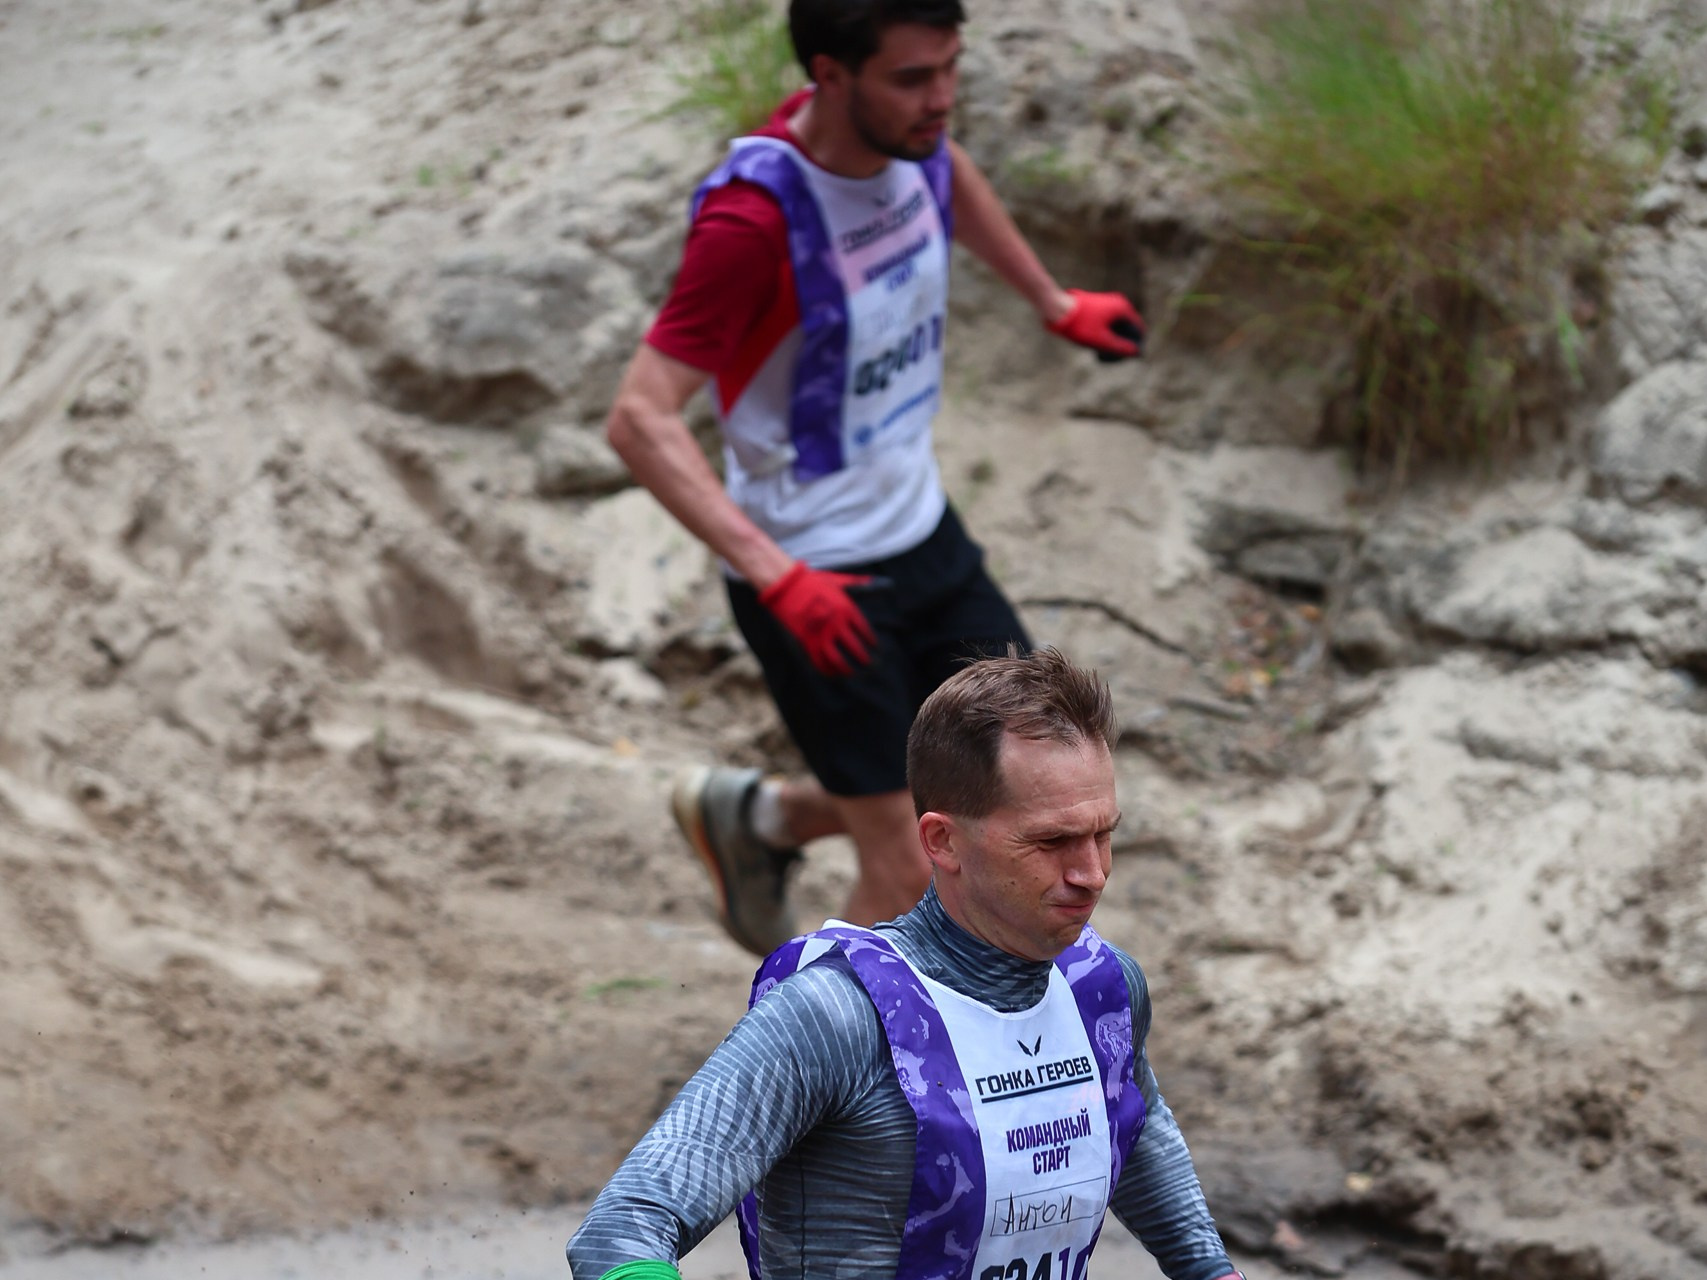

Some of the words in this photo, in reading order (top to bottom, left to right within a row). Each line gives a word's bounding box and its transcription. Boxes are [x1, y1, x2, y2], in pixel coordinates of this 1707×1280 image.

[975, 1068, 1035, 1096] ГОНКА
[1038, 1056, 1092, 1084] ГЕРОЕВ
[1006, 1107, 1092, 1153] КОМАНДНЫЙ
[1032, 1146, 1071, 1175] СТАРТ
